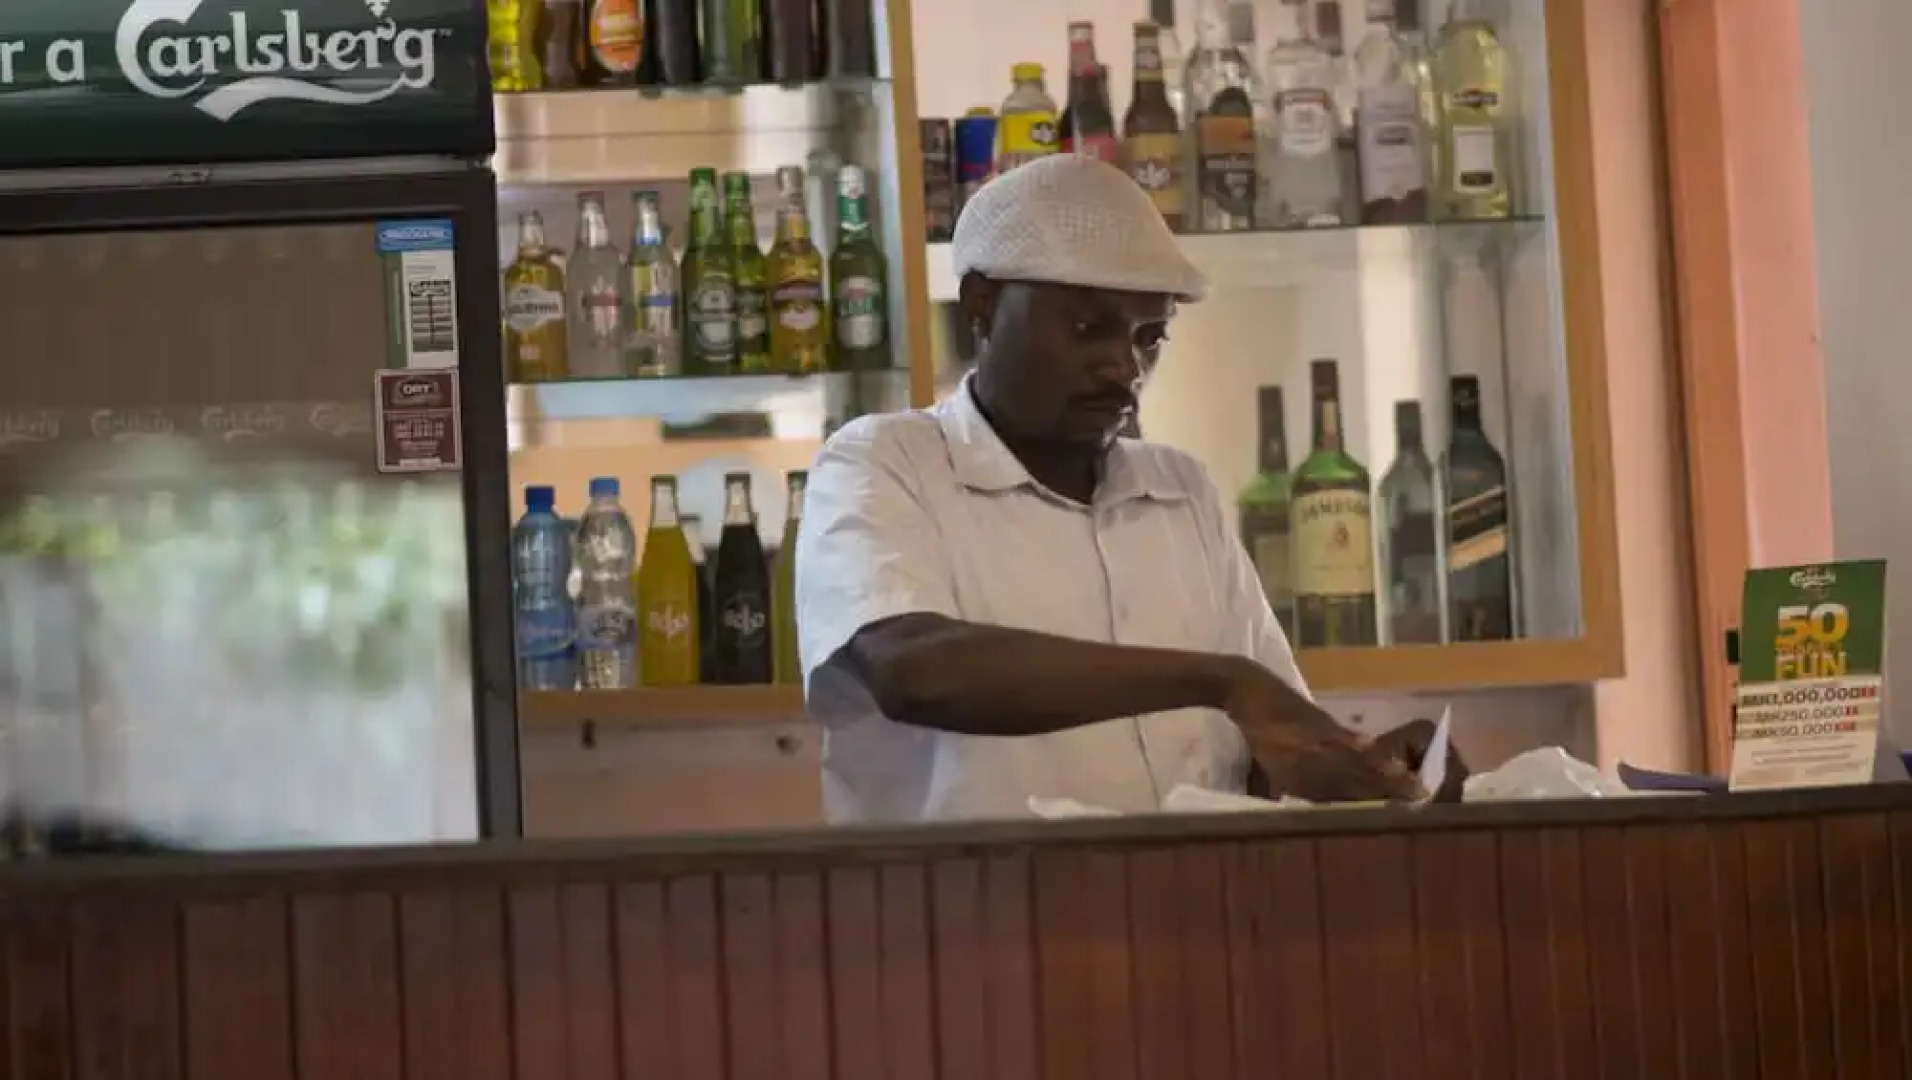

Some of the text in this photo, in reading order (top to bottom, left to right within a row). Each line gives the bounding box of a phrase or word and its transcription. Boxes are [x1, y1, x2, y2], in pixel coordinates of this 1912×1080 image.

[46, 37, 85, 82] a
[115, 0, 436, 121] Carlsberg
[1774, 603, 1850, 645] 50
[1776, 650, 1848, 681] FUN
